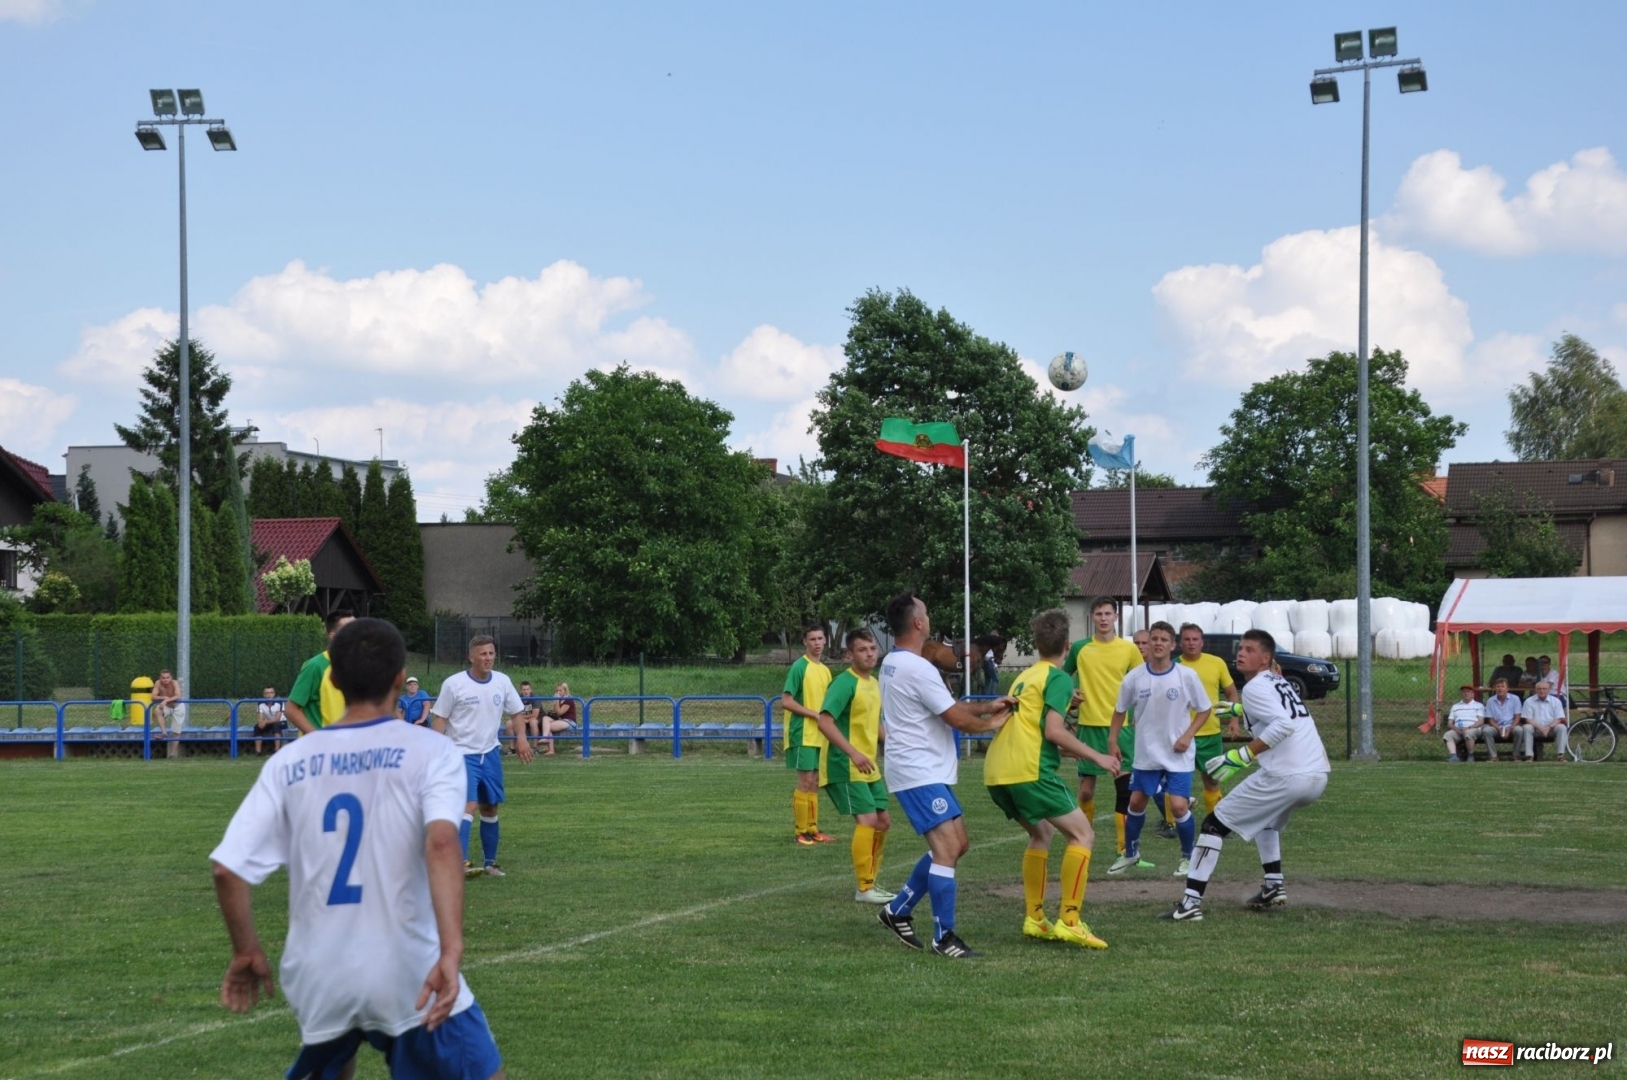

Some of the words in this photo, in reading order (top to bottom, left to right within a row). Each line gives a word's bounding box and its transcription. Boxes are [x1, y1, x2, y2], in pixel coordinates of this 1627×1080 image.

[285, 759, 306, 786] LKS
[309, 753, 325, 777] 07
[330, 748, 406, 776] MARKOWICE
[323, 792, 364, 906] 2
